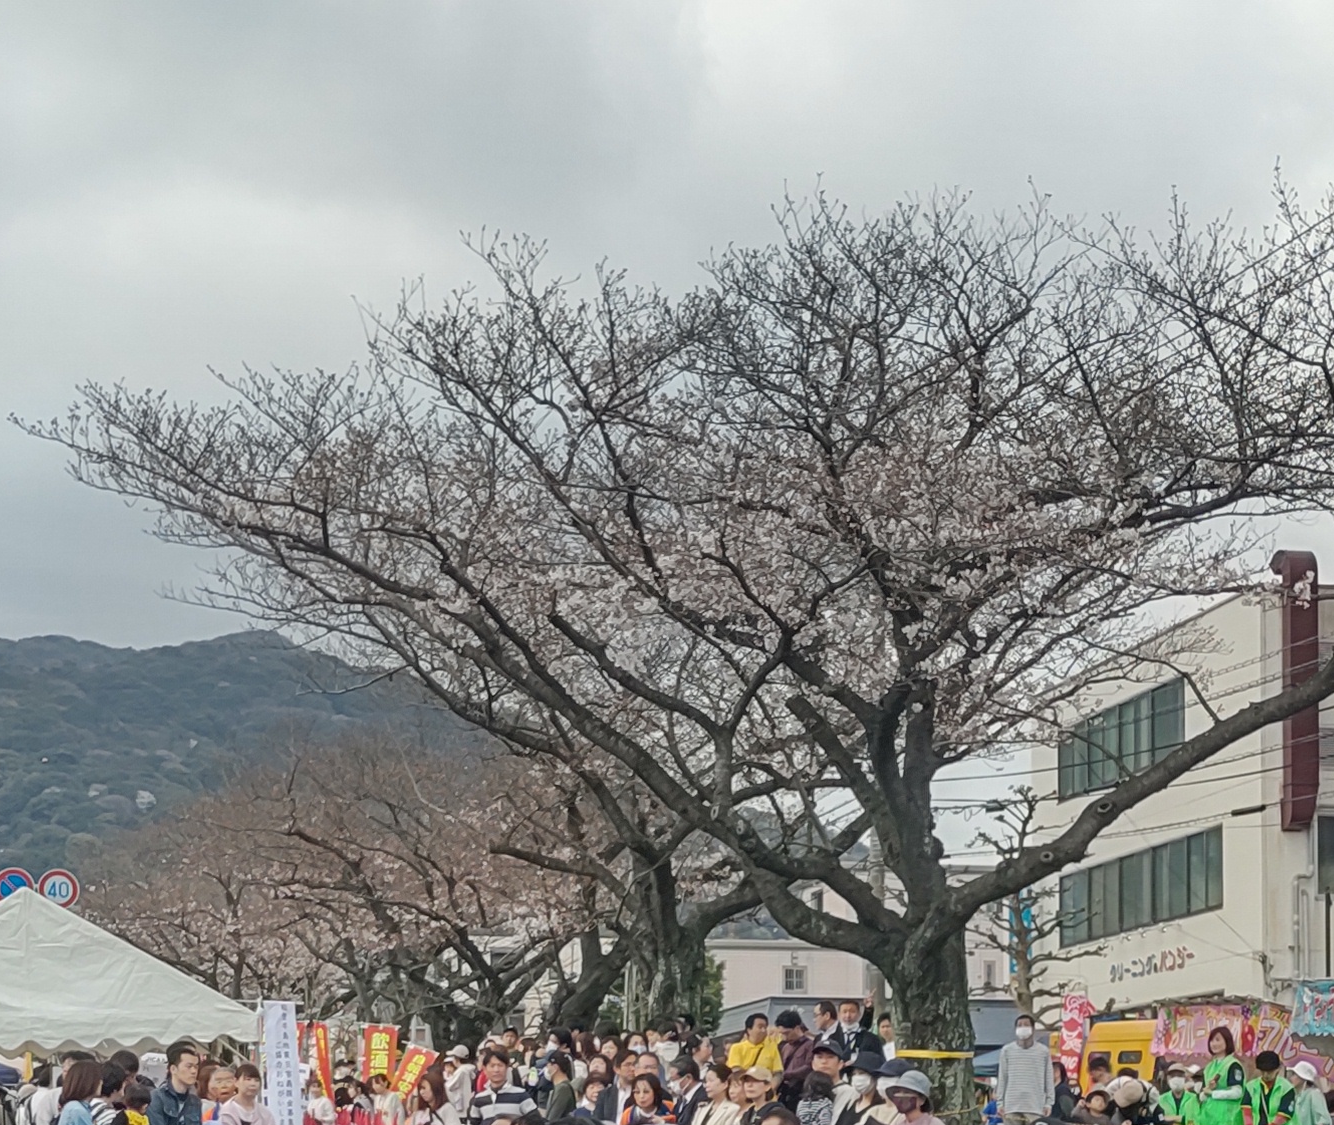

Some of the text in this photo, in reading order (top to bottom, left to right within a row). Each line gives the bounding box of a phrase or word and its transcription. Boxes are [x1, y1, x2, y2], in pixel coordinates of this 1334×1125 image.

[48, 881, 69, 898] 40
[1110, 954, 1156, 983] クリーニング
